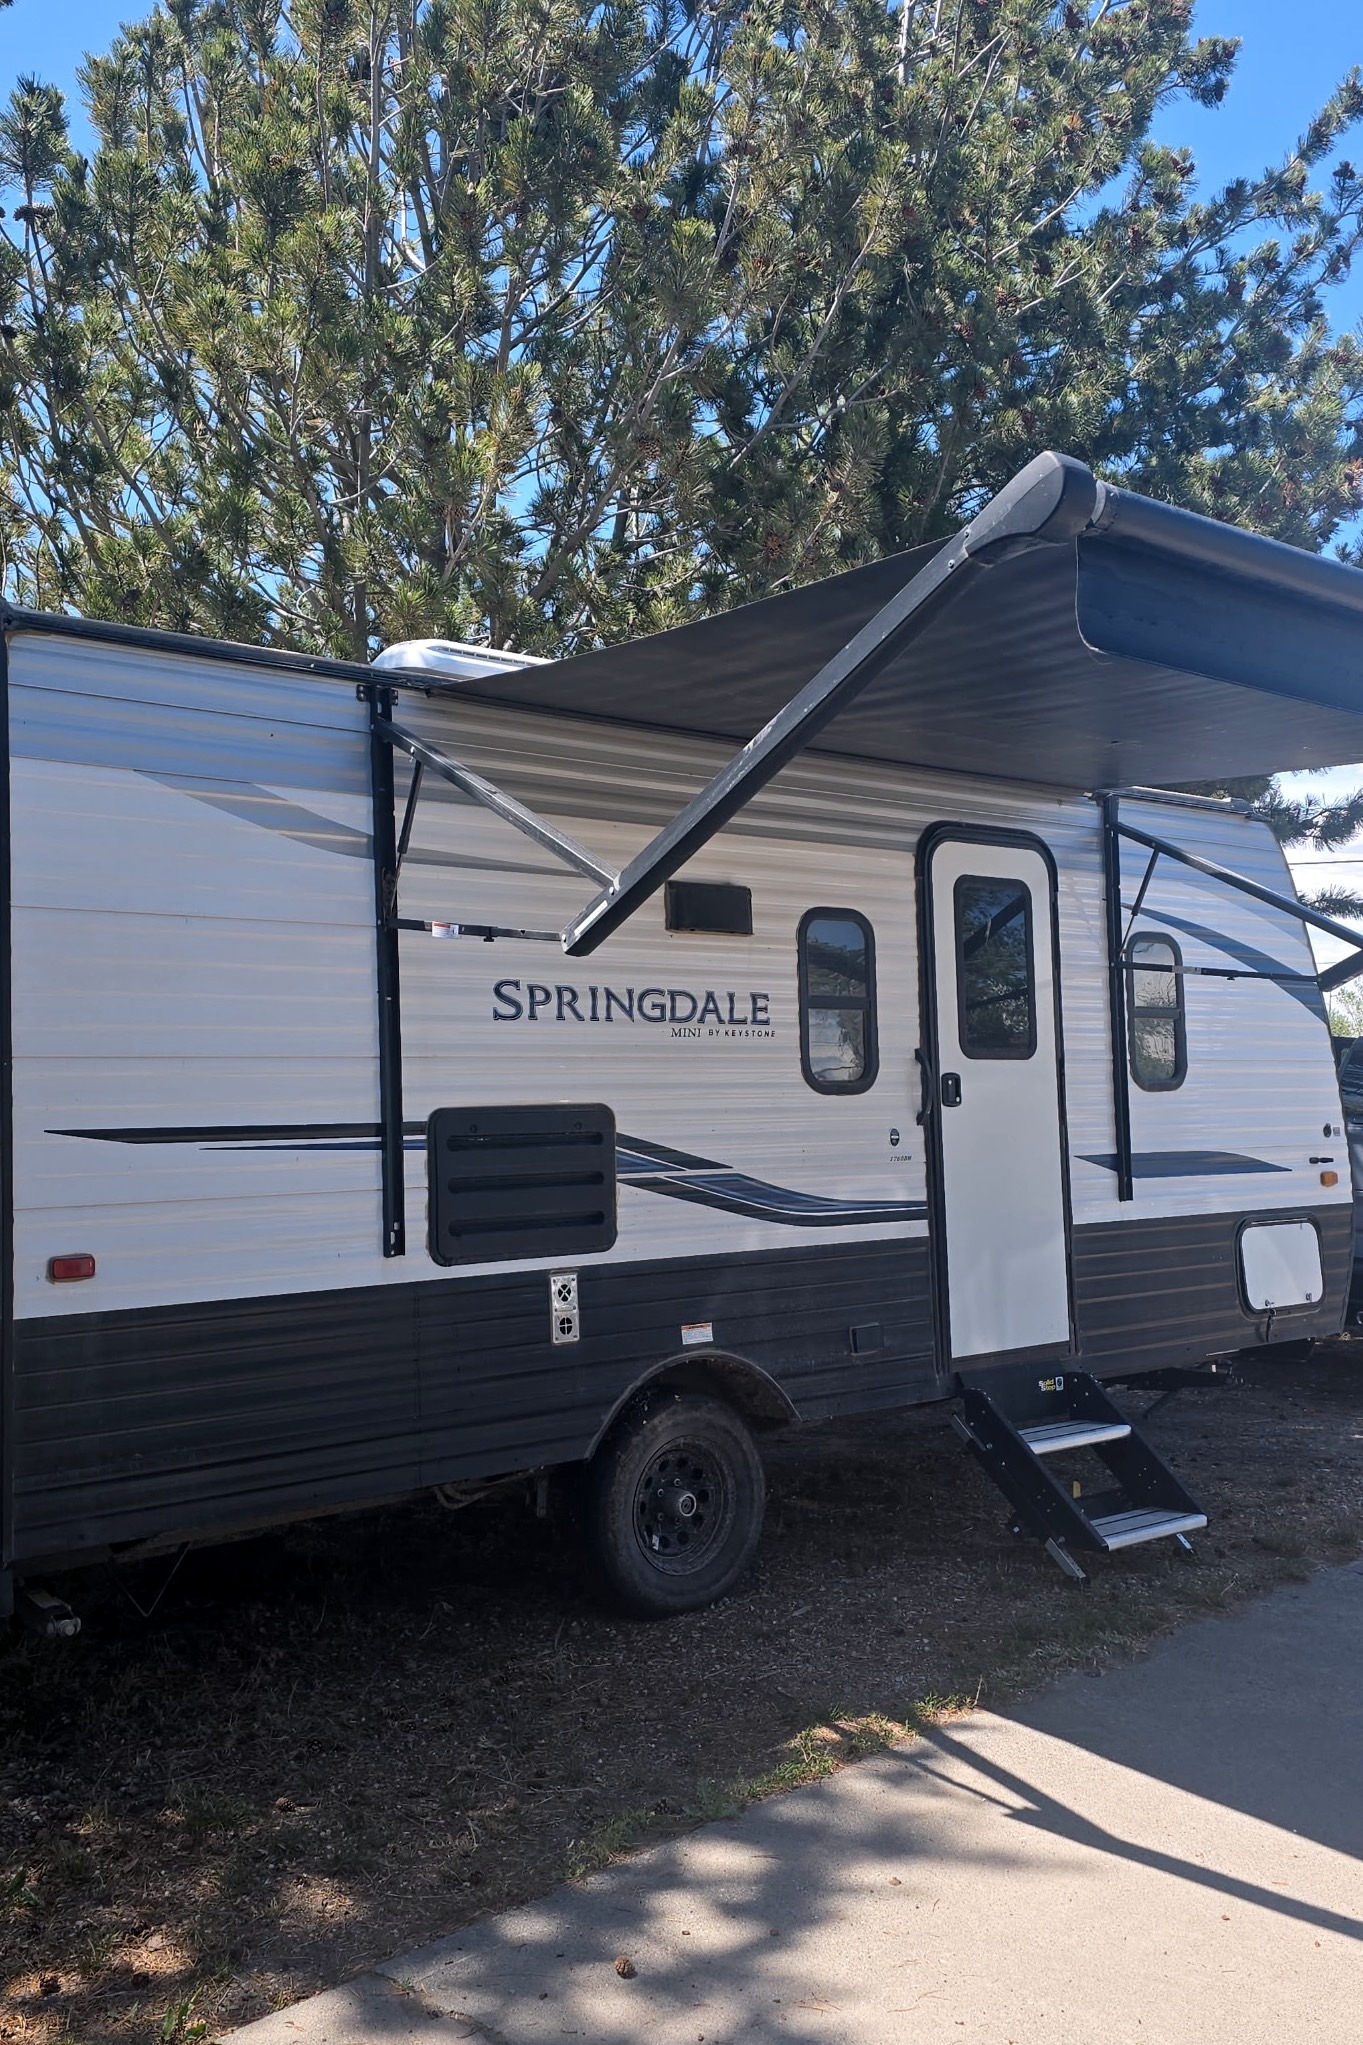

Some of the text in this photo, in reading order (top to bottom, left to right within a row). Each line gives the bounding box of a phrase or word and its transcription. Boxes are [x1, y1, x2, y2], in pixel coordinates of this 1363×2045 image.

[493, 979, 771, 1026] SPRINGDALE
[671, 1027, 777, 1038] MINI BY KEYSTONE
